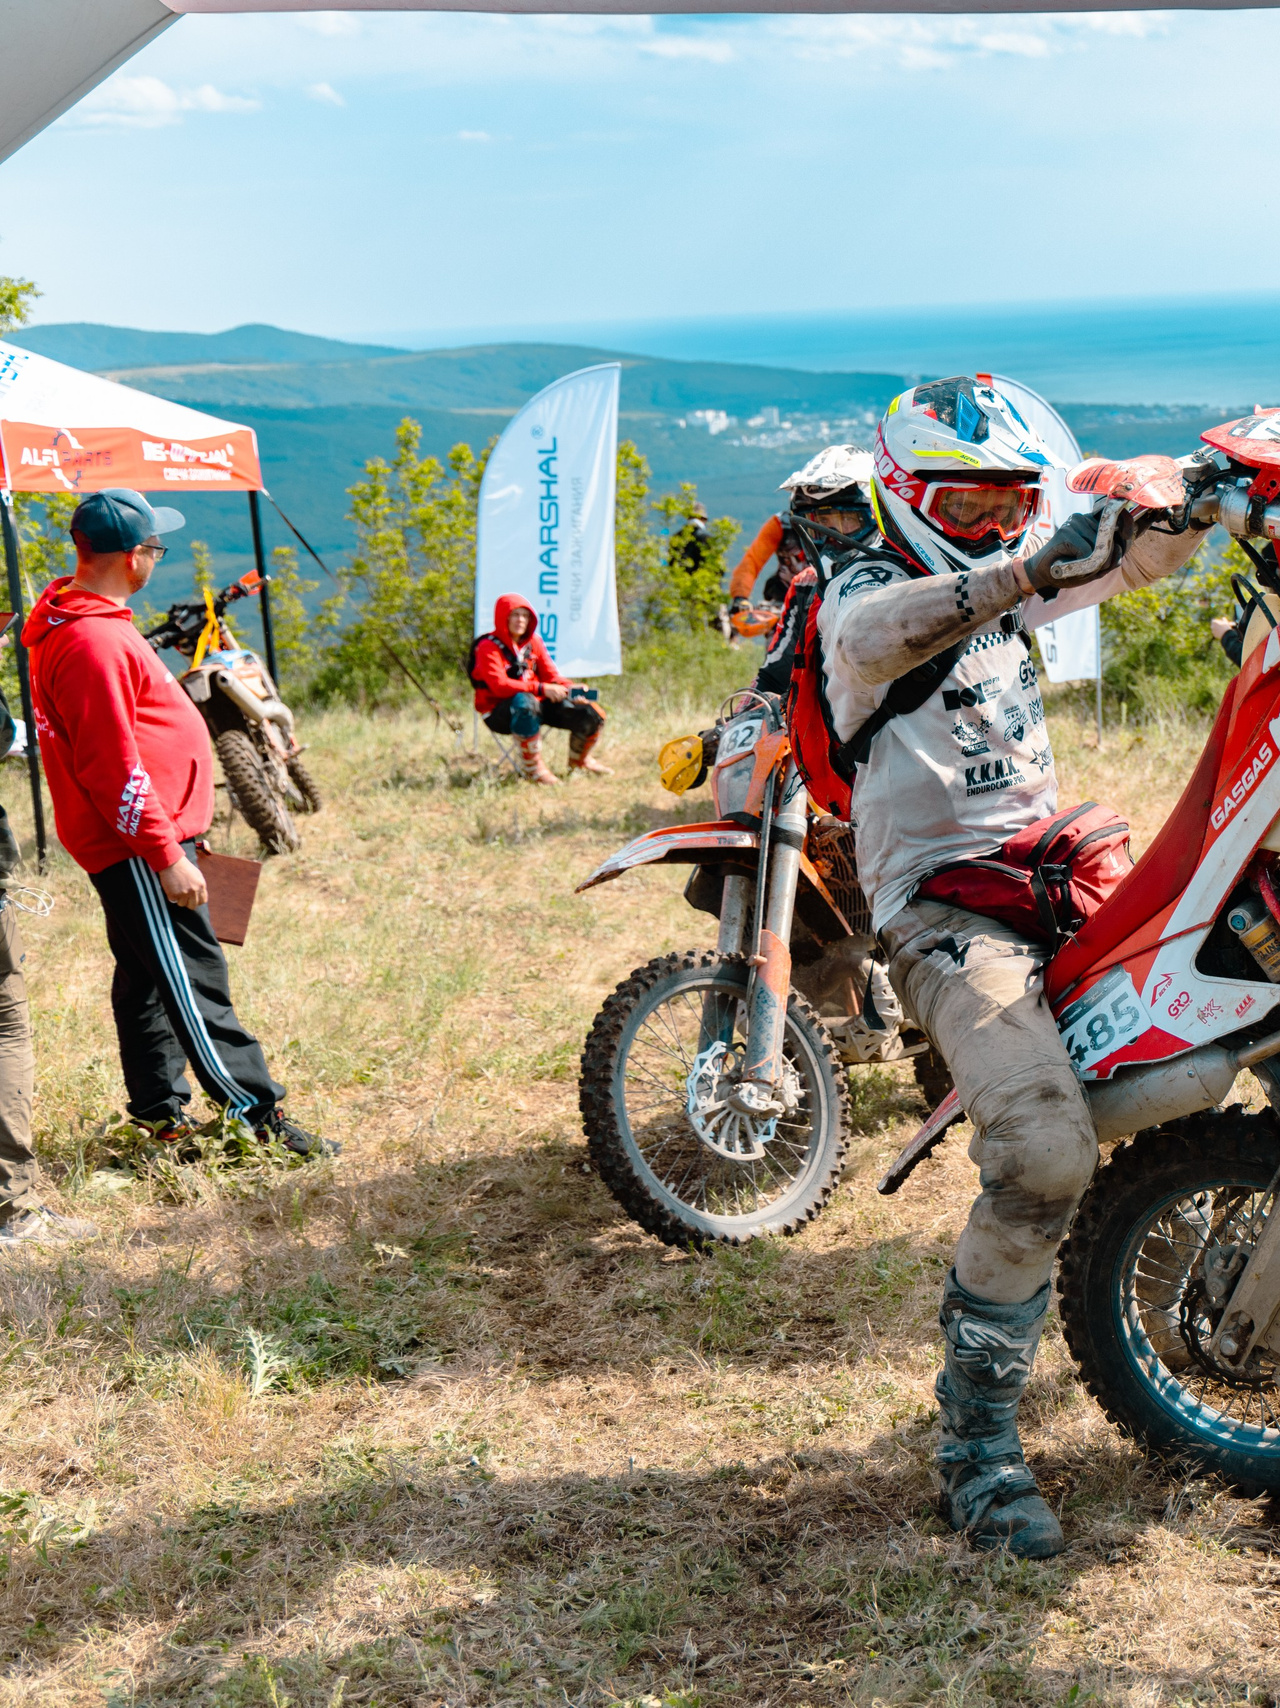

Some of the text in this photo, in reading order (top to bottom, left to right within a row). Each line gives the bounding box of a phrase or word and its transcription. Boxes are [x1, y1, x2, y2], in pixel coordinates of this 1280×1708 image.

[20, 447, 60, 467] ALFI
[570, 573, 584, 623] СВЕЧИ
[966, 774, 1027, 797] ENDUROCAMP.PRO
[1210, 742, 1273, 830] GASGAS
[128, 796, 146, 838] RACING
[1066, 991, 1140, 1063] 485
